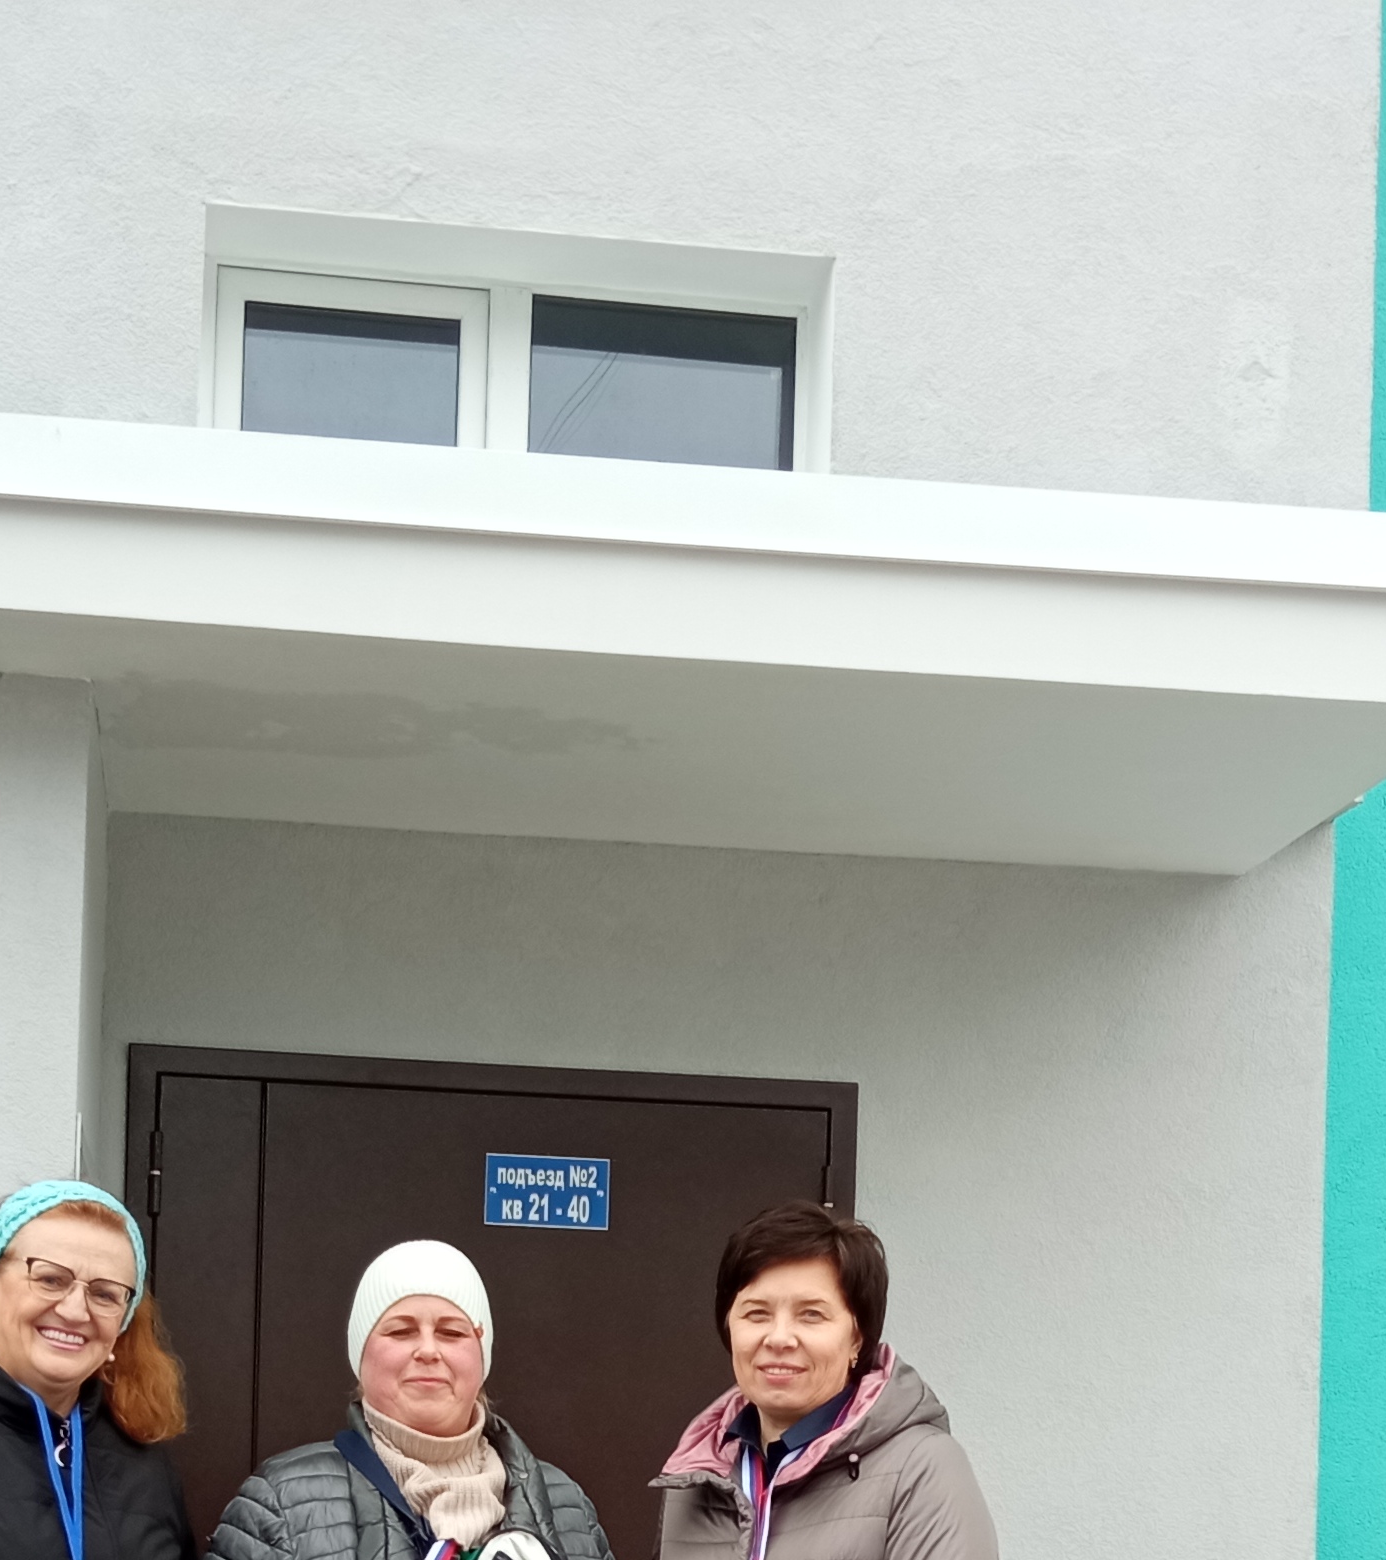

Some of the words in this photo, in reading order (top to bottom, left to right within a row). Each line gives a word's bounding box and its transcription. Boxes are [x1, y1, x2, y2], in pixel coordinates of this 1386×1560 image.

[497, 1167, 565, 1191] подъезд
[569, 1165, 598, 1189] №2
[501, 1199, 522, 1220] кв
[528, 1193, 549, 1222] 21
[567, 1194, 590, 1224] 40
